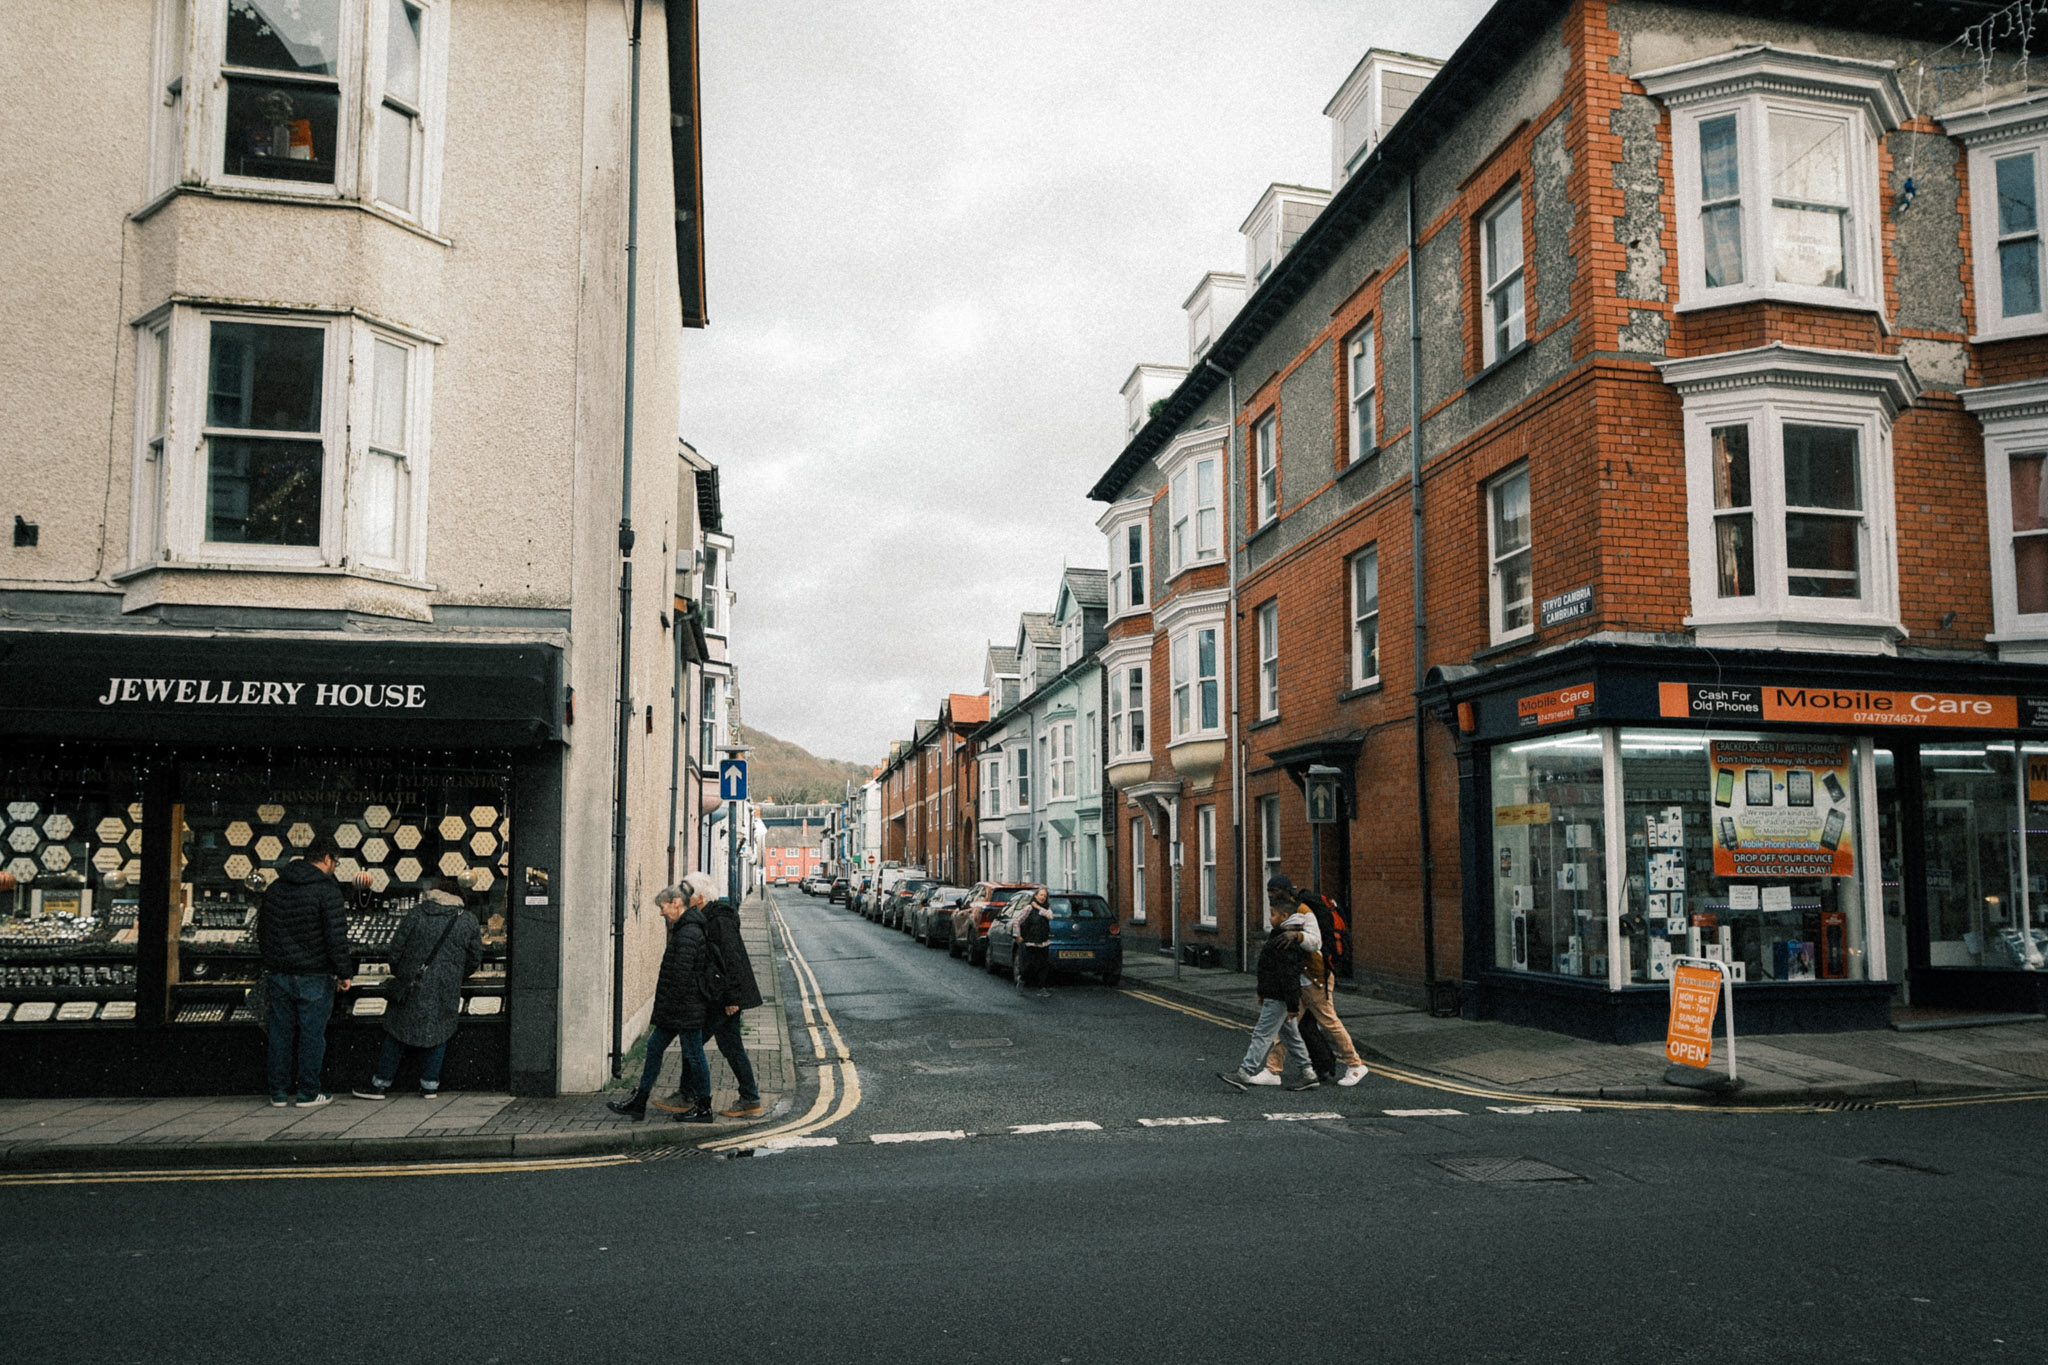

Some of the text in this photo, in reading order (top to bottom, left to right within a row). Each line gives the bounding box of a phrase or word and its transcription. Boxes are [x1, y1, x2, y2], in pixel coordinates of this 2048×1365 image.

[1542, 586, 1591, 612] STRYD CAMBRIA
[1546, 604, 1579, 624] CAMBRIAN
[99, 677, 427, 709] JEWELLERY HOUSE
[1698, 689, 1752, 702] Cash For
[1521, 690, 1590, 712] Mobile Care
[1692, 700, 1760, 712] Old Phones
[1776, 689, 1993, 715] Mobile Care
[1853, 712, 1928, 724] 07479746747
[1716, 742, 1748, 751] CRACKED
[1749, 742, 1775, 752] SCREEN
[1784, 744, 1806, 752] WATER
[1807, 744, 1836, 753] DAMAGE
[1717, 756, 1738, 764] Don't
[1739, 756, 1763, 764] Throw
[1741, 840, 1820, 850] Mobile Phone Unlocking
[1733, 854, 1833, 862] DROP OFF YOUR DEVICE
[1736, 866, 1744, 874] &
[1744, 866, 1782, 874] COLLECT
[1784, 866, 1808, 874] SAME
[1809, 866, 1826, 874] DAY
[1679, 993, 1694, 1002] MON
[1698, 996, 1711, 1004] SAT
[1679, 1013, 1706, 1024] SUNDAY
[1670, 1040, 1706, 1062] OPEN
